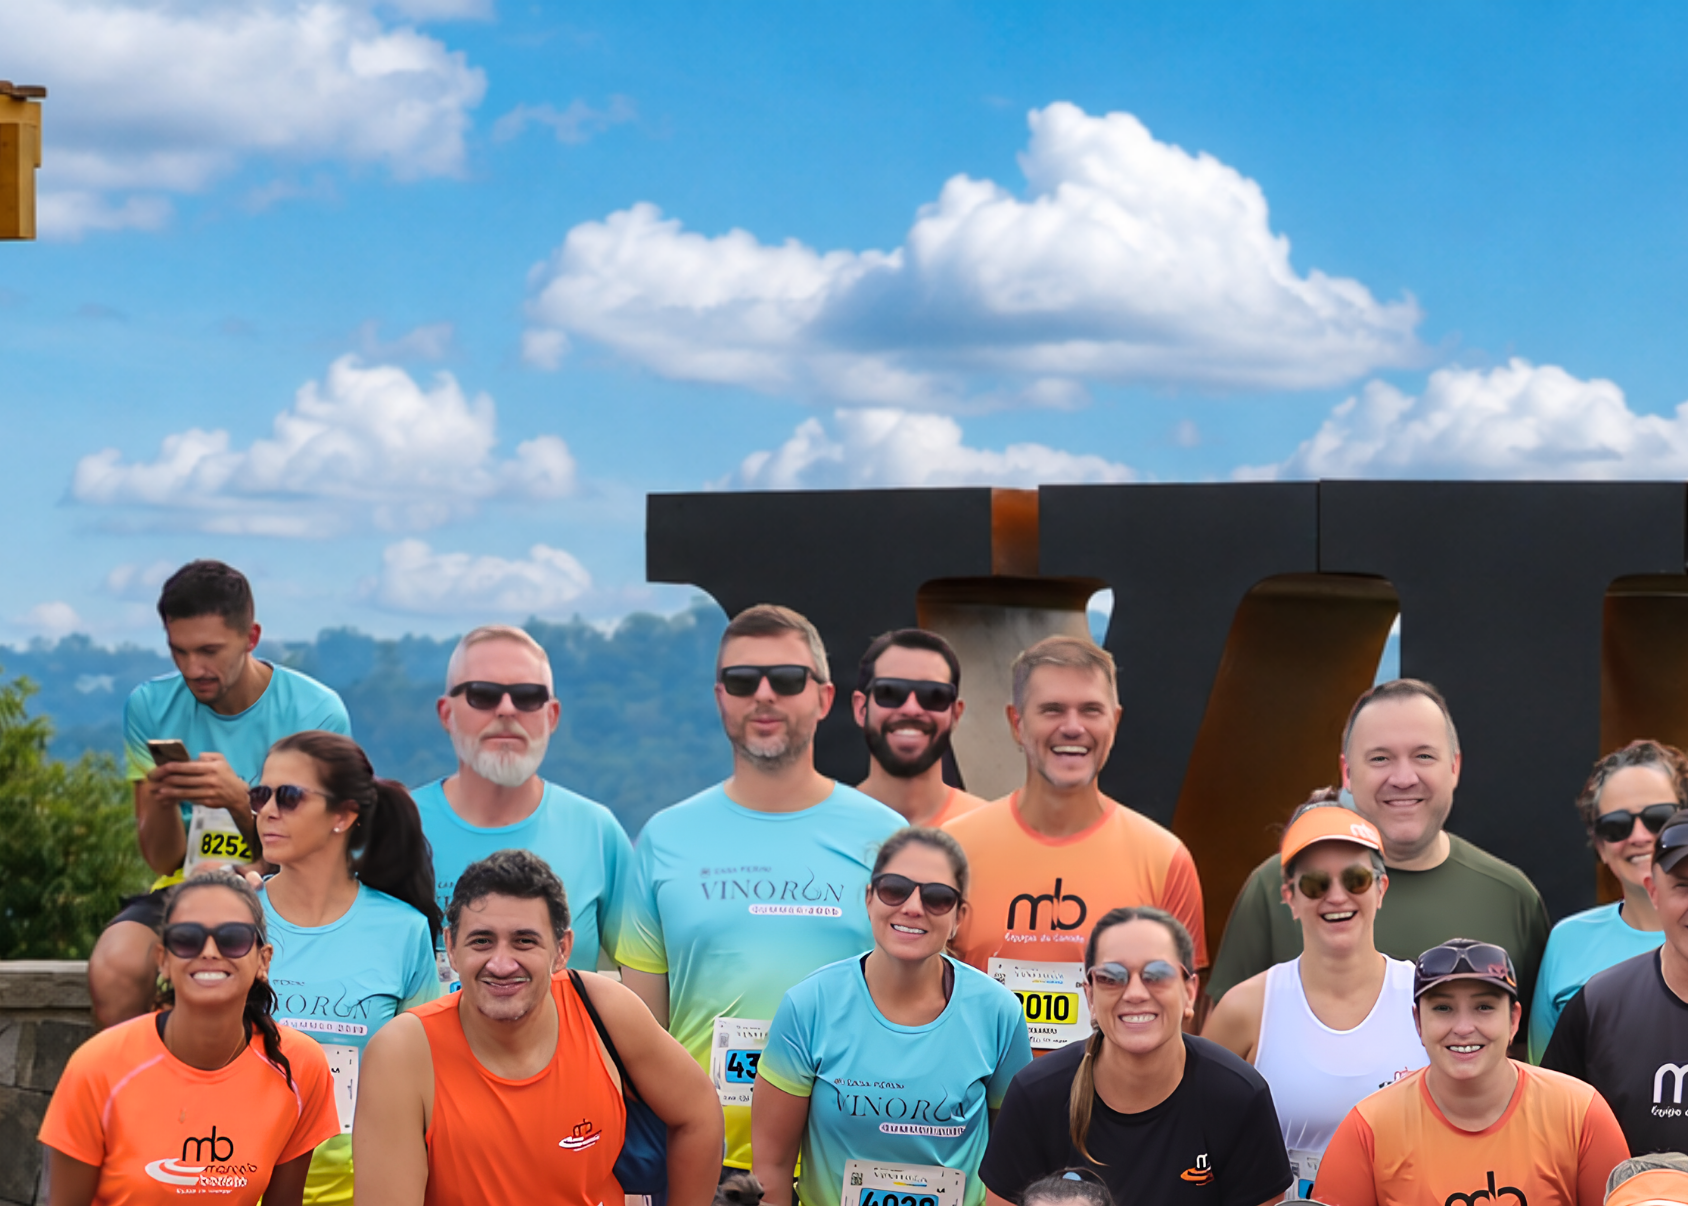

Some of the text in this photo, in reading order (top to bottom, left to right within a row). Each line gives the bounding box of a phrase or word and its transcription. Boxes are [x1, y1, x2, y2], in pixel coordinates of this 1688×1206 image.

[201, 832, 252, 859] 8252
[1007, 877, 1088, 931] mb
[182, 1125, 234, 1162] mb
